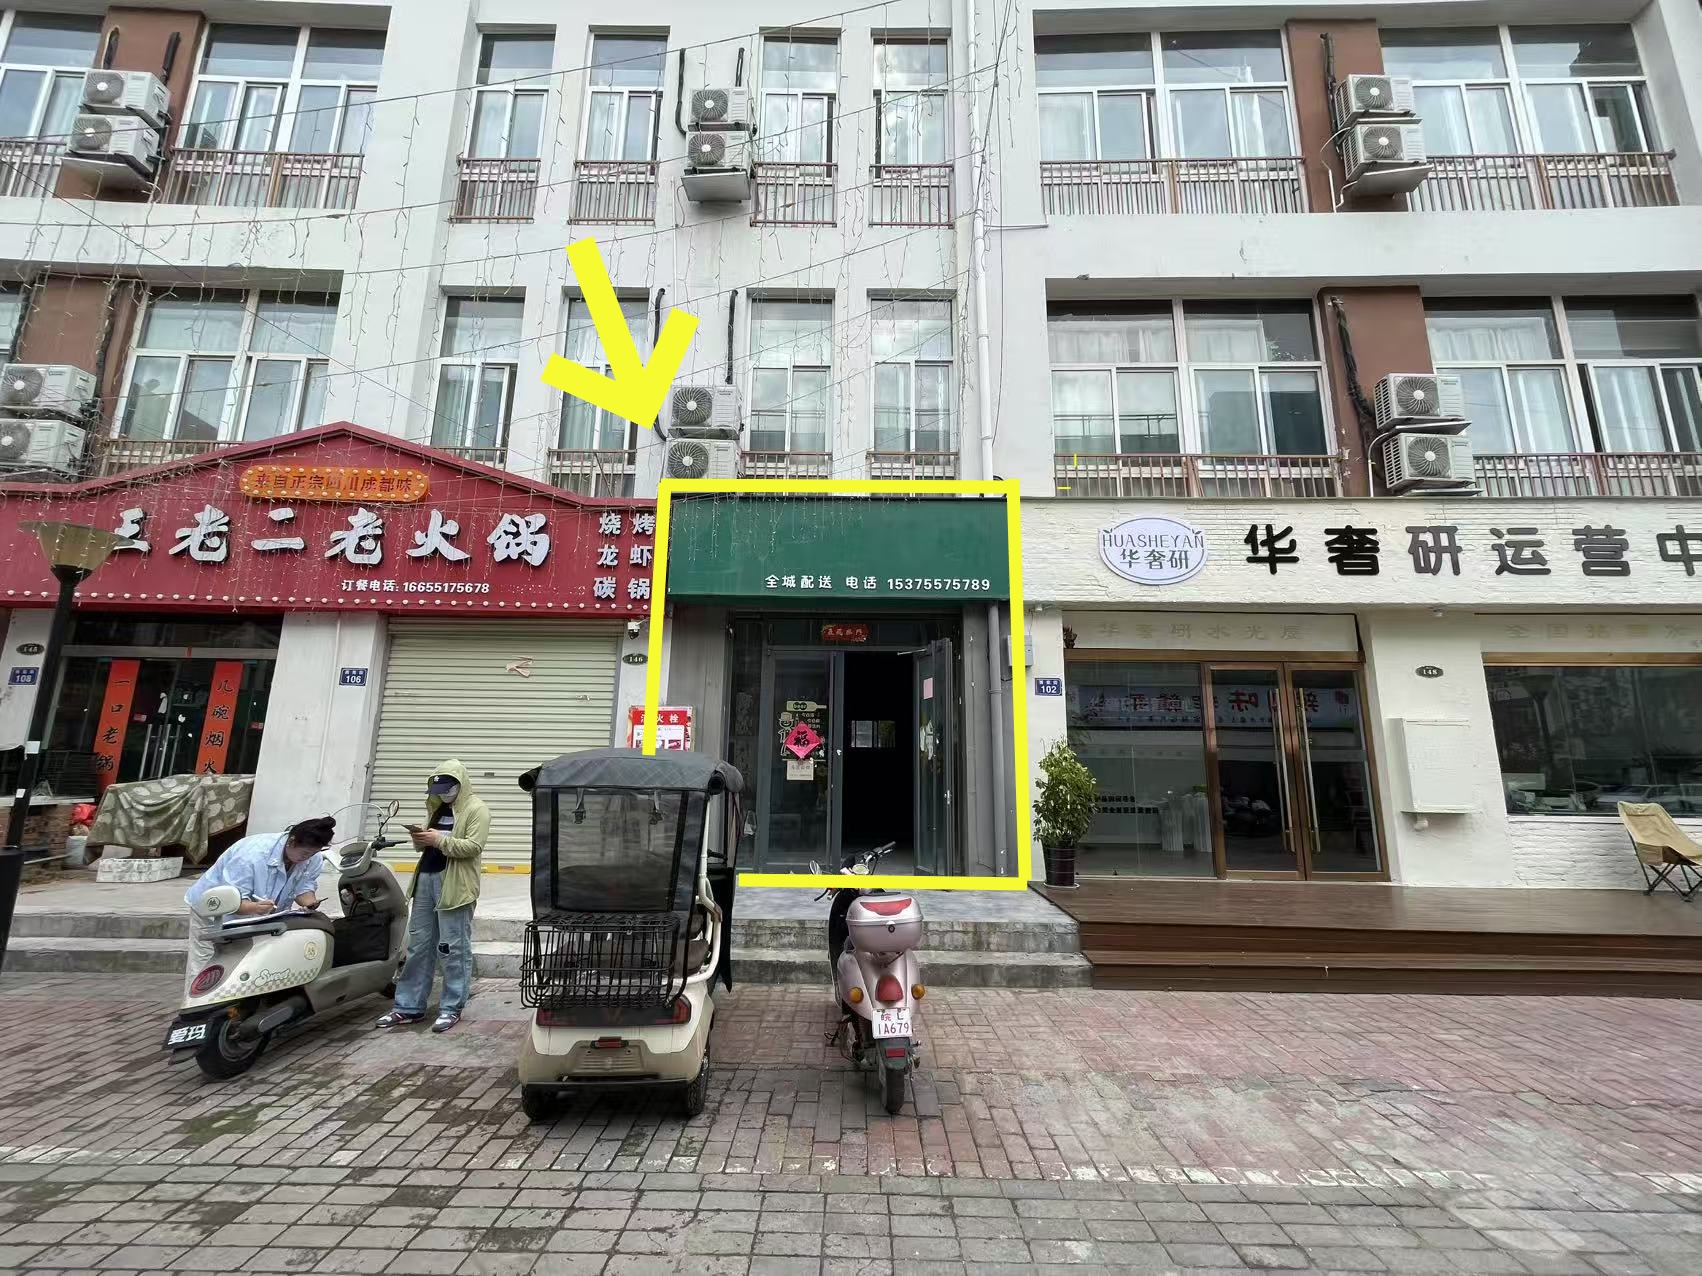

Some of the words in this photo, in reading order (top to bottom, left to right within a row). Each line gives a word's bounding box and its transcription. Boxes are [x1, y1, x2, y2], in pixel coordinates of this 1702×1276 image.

[599, 512, 655, 536] 烧烤
[113, 504, 551, 567] 王老二老火锅
[1102, 534, 1204, 548] HUASHEYAN
[597, 544, 653, 567] 龙虾
[1120, 549, 1190, 570] 华奢研
[1244, 524, 1702, 577] 华奢研运营中
[593, 576, 650, 600] 碳锅
[765, 574, 832, 589] 全城配送
[846, 575, 877, 589] 电话
[887, 578, 991, 590] 15375575789
[16, 674, 32, 683] 108
[346, 675, 361, 683] 106
[1041, 685, 1057, 693] 102
